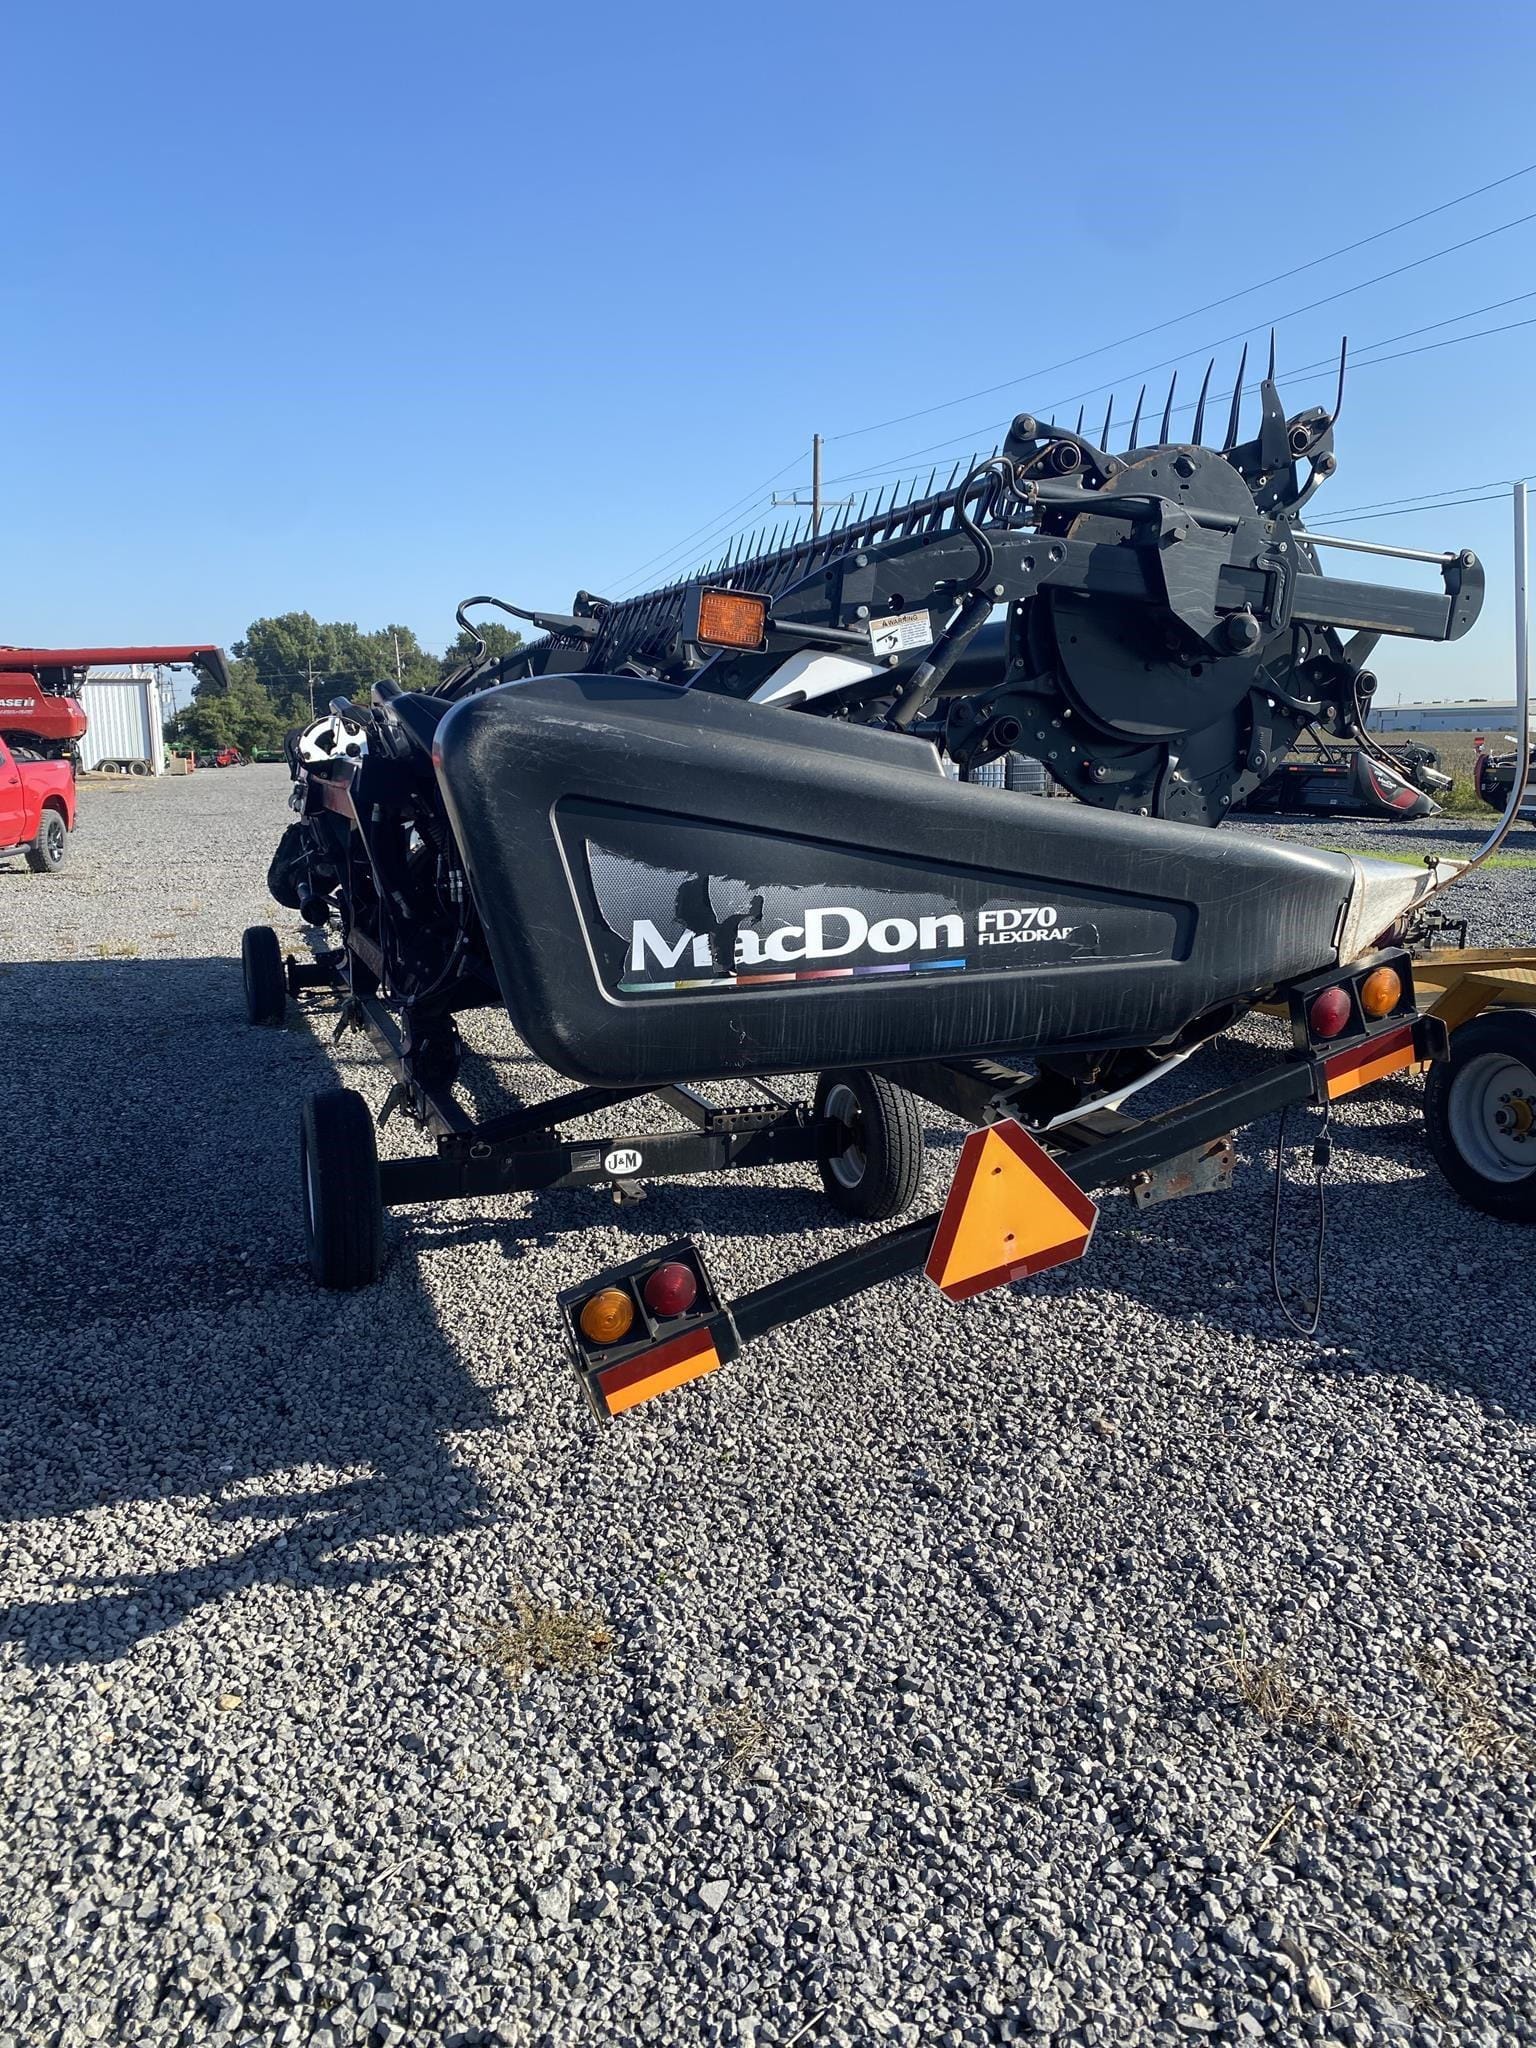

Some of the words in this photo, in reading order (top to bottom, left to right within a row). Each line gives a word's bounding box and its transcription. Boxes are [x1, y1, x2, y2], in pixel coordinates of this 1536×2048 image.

[631, 907, 965, 970] MacDon
[978, 906, 1058, 932] FD70
[978, 926, 1079, 945] FLEXDRAP
[608, 1152, 637, 1170] J&M
